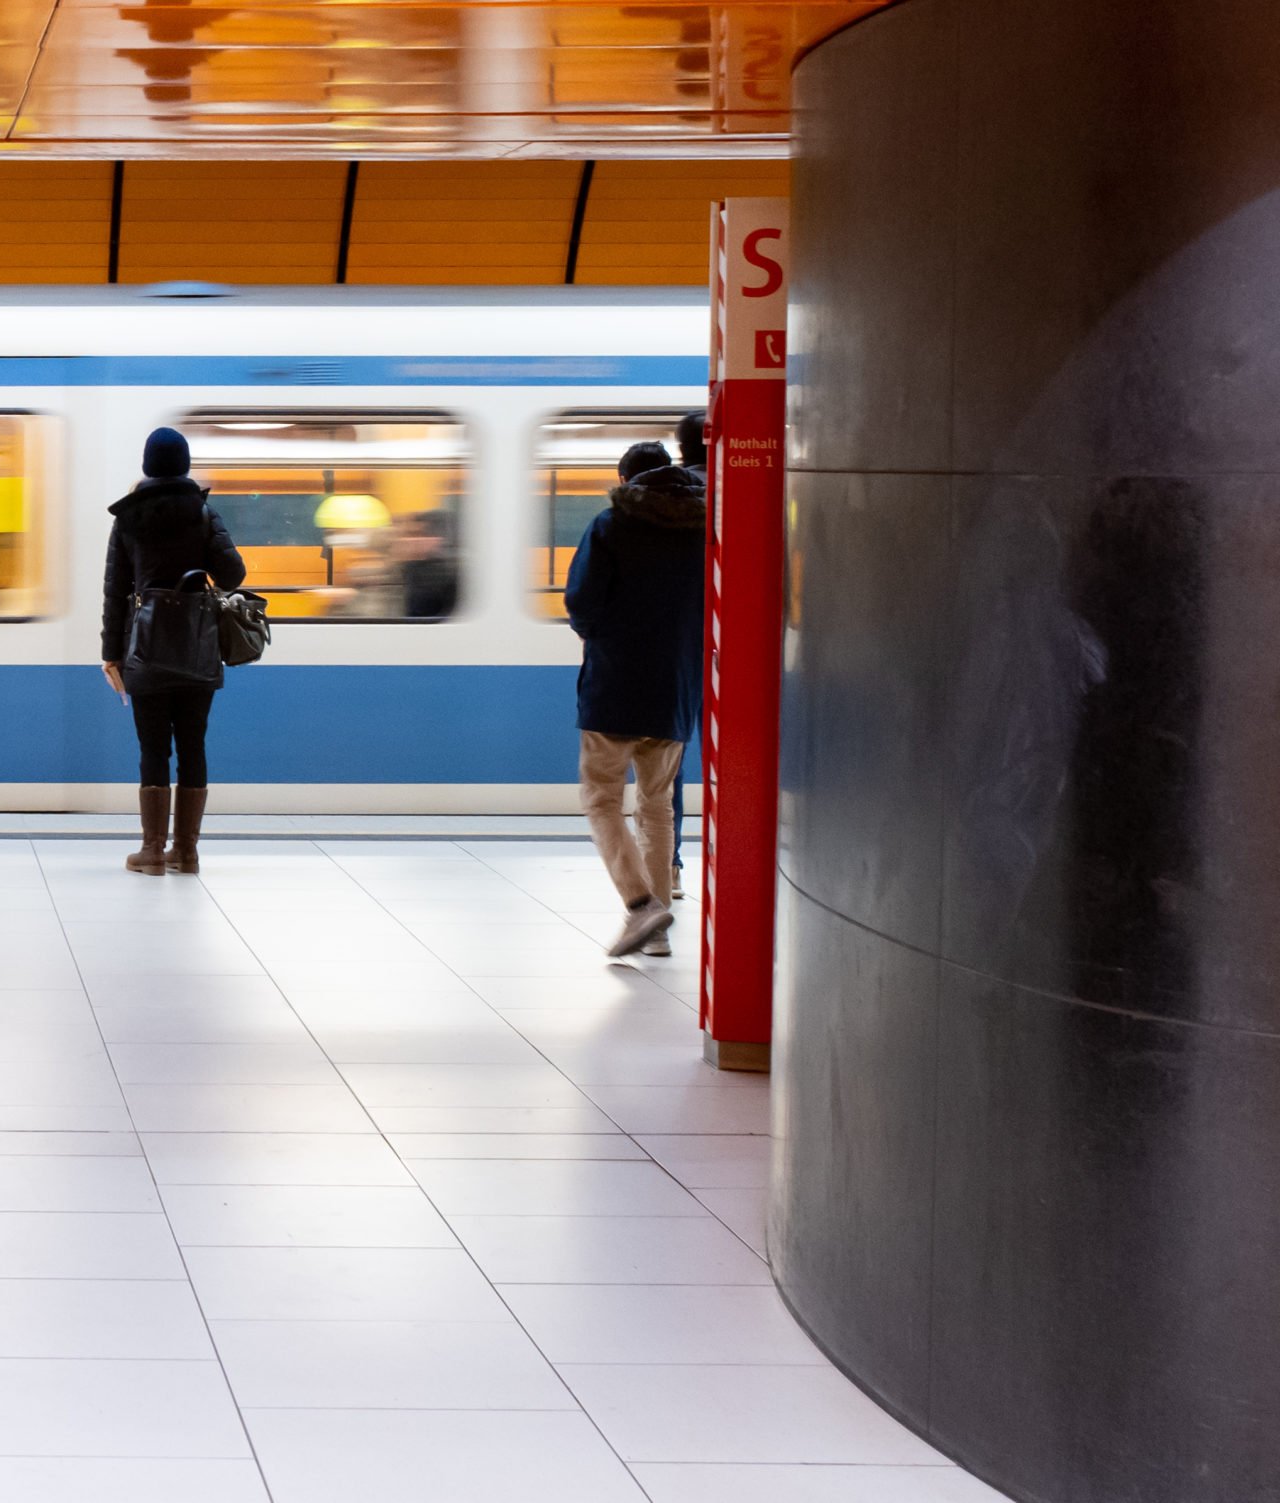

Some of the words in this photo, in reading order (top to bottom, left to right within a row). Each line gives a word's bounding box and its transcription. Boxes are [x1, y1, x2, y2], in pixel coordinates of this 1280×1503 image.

[741, 228, 783, 298] S
[729, 437, 777, 449] Nothalt
[729, 455, 760, 468] Gleis
[765, 455, 773, 468] 1
